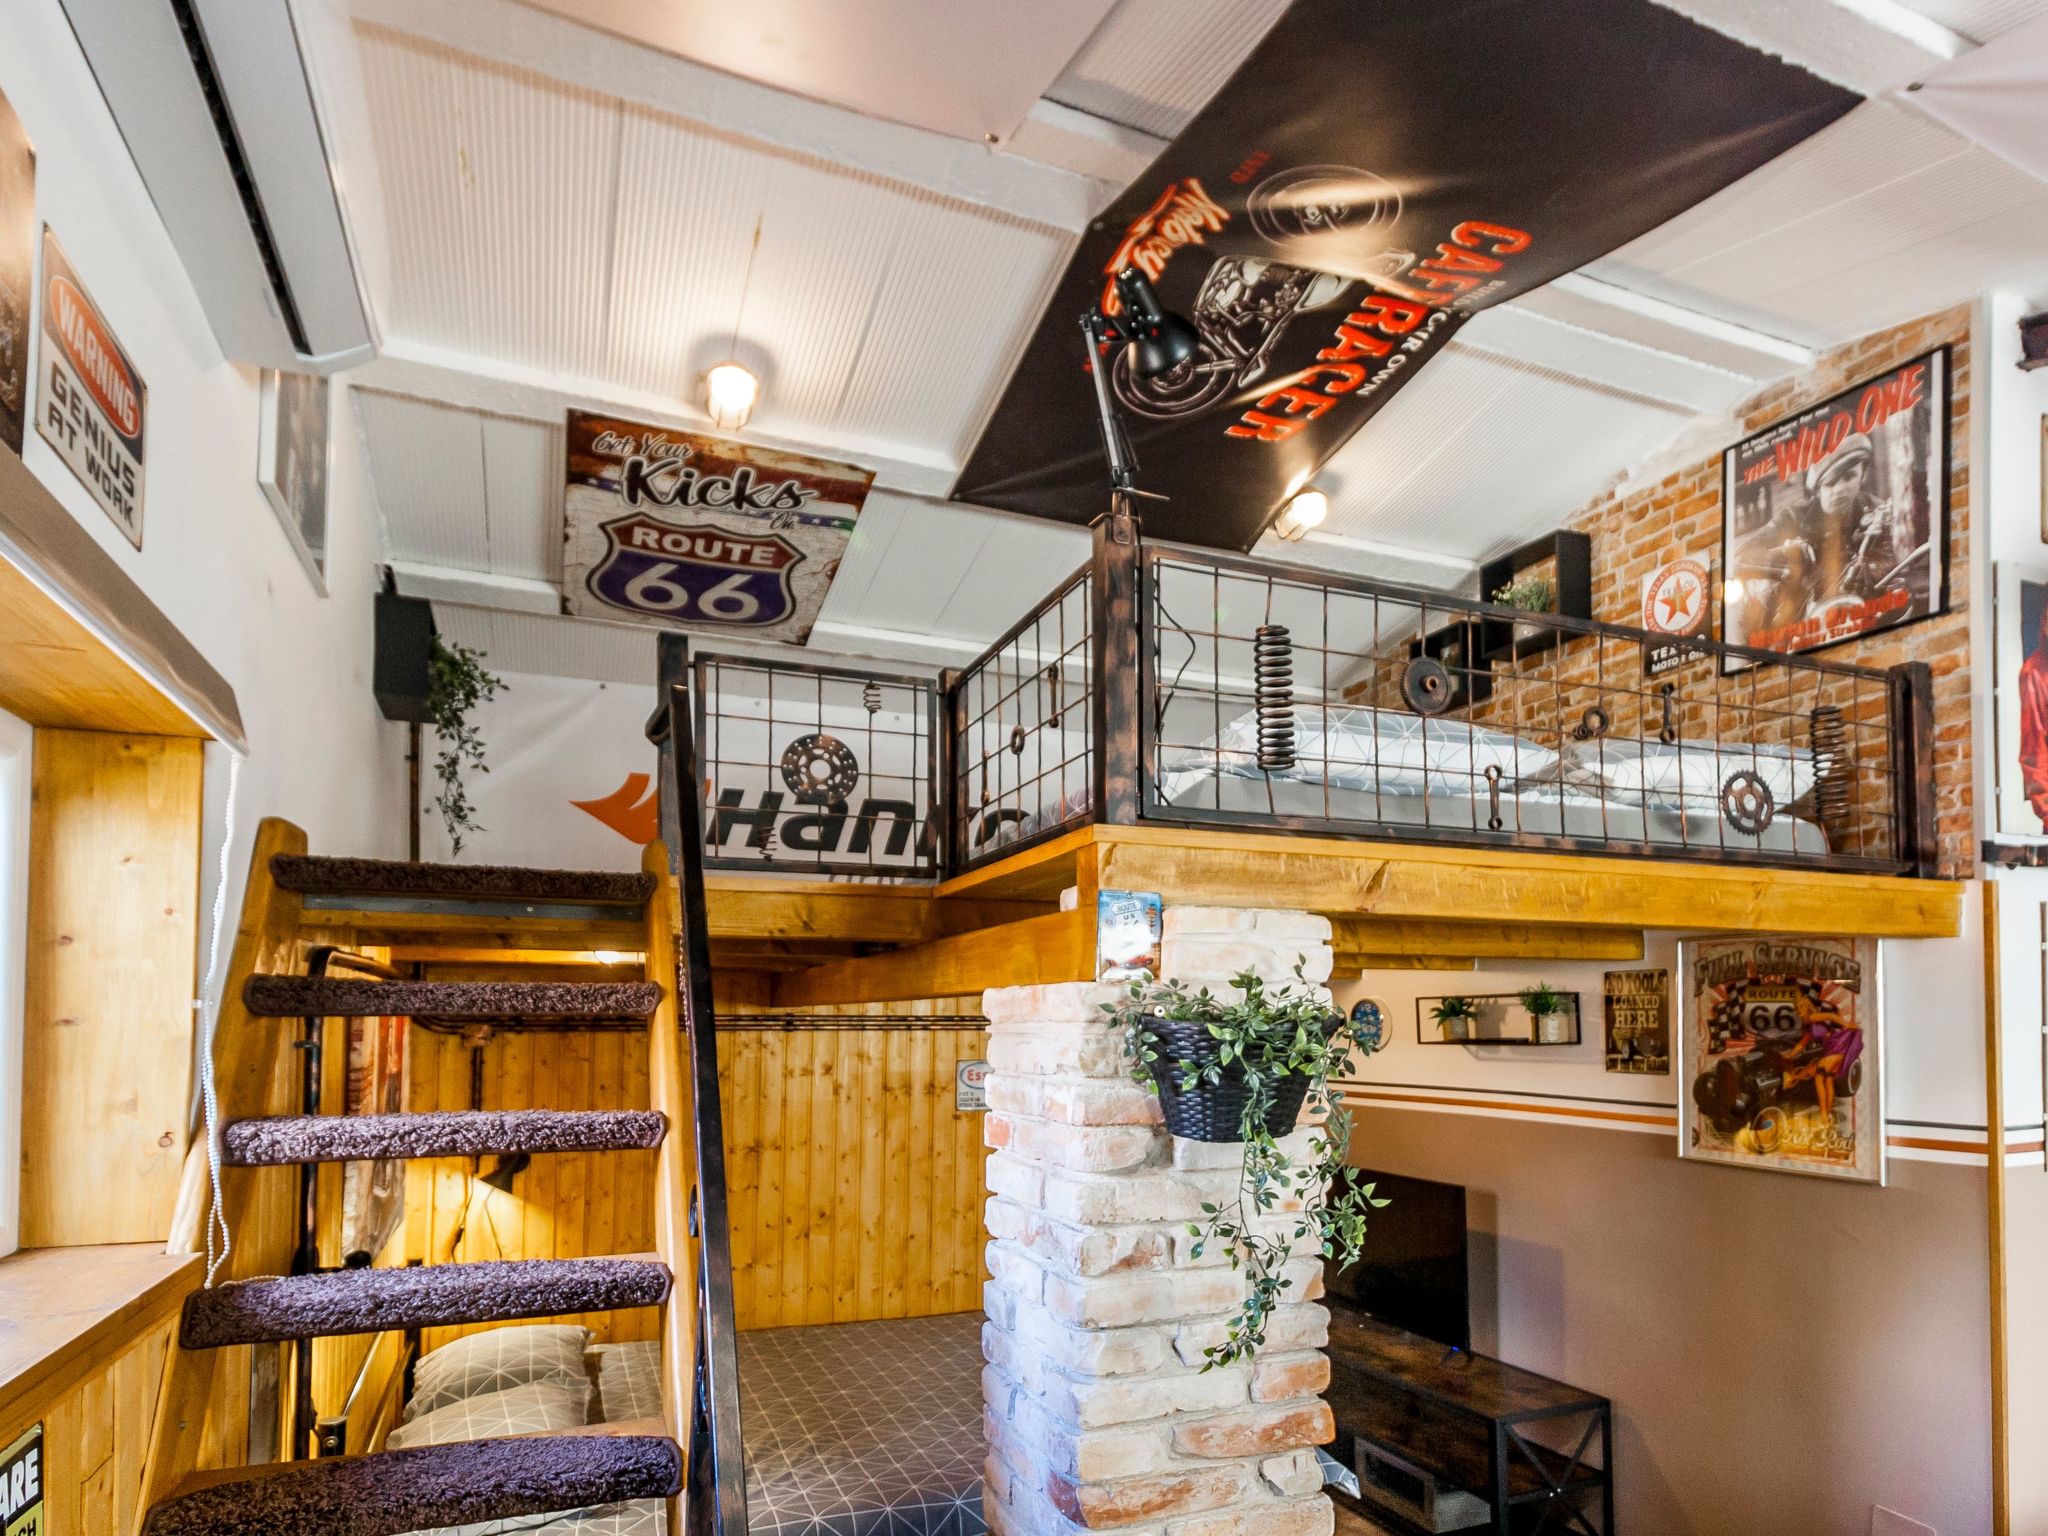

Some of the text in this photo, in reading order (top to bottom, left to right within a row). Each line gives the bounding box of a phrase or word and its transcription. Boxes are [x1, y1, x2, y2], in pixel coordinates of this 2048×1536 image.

[58, 284, 134, 432] WARNING
[1224, 294, 1430, 442] RACER
[1356, 353, 1407, 396] OWN
[50, 361, 136, 498] GENIUS
[592, 430, 694, 459] Get Your
[1743, 453, 1776, 485] THE
[1775, 410, 1853, 482] WILD
[1855, 363, 1926, 435] ONE
[48, 400, 134, 528] AT WORK
[620, 455, 820, 511] Kicks
[631, 525, 777, 565] ROUTE
[624, 562, 760, 620] 66
[1117, 902, 1137, 912] ROUTE
[1694, 941, 1861, 997] FULL SERVICE
[1613, 995, 1660, 1009] LOANED
[1614, 1009, 1659, 1028] HERE
[1748, 988, 1798, 1000] ROUTE
[1749, 1004, 1796, 1032] 66
